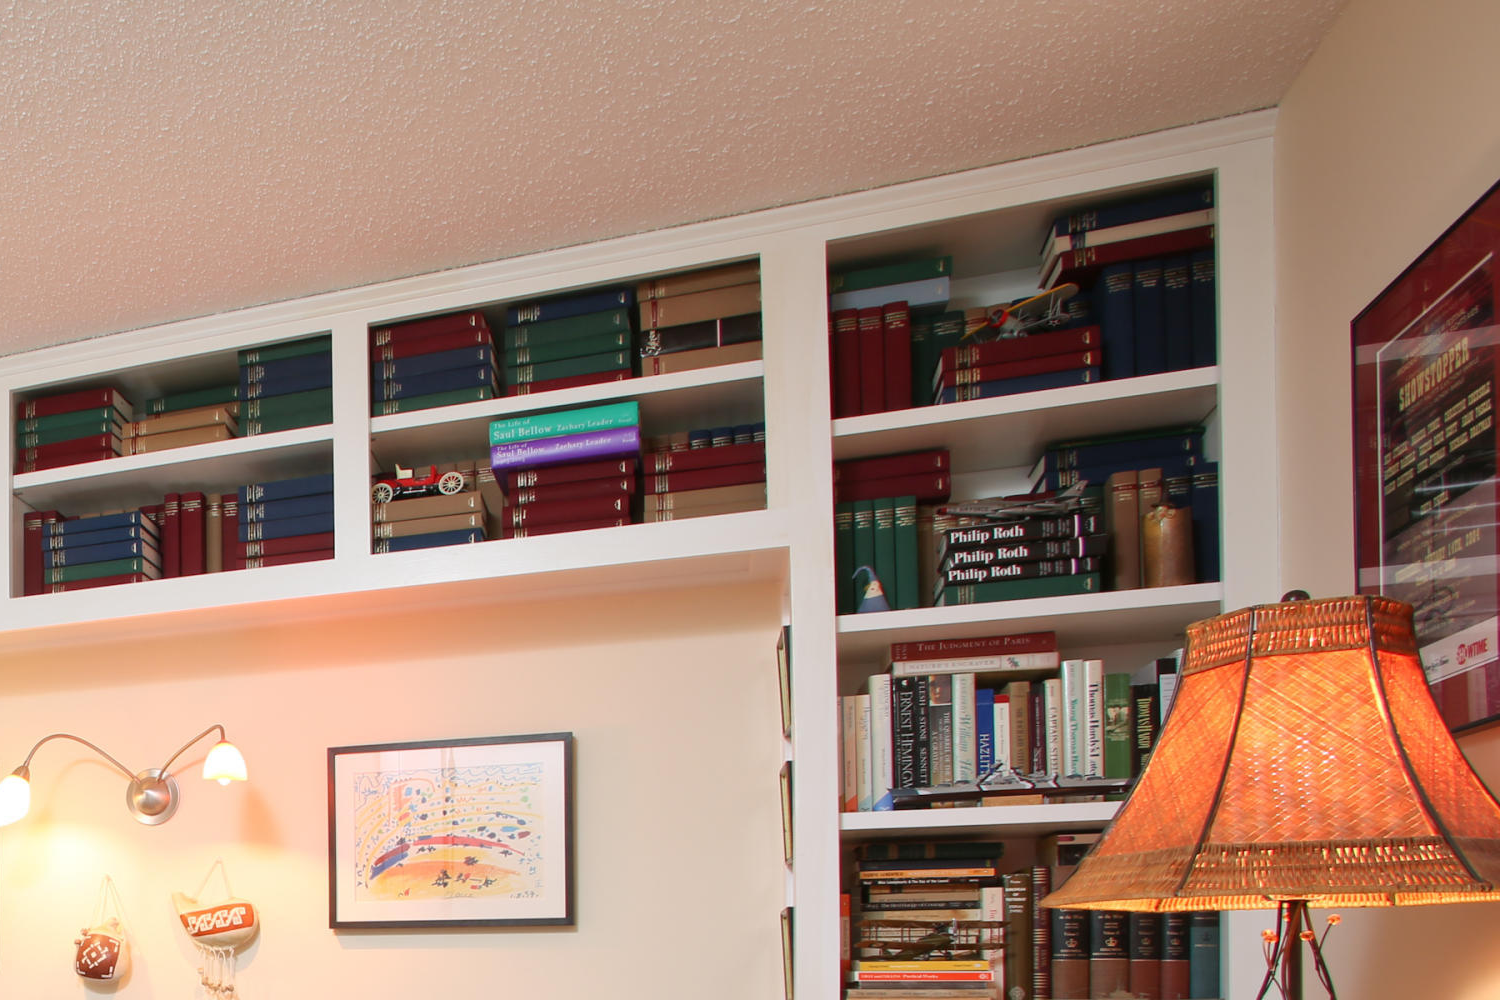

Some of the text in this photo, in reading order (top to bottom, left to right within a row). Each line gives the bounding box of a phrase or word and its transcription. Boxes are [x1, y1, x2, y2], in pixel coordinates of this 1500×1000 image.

[1399, 337, 1469, 412] SHOWSTOPPER
[494, 425, 552, 440] Saul Bellow
[508, 420, 521, 428] Life
[557, 422, 585, 432] Zachary
[588, 417, 613, 427] Leader
[497, 446, 545, 458] Saul Bellow
[556, 437, 612, 450] Zachary Leader
[950, 525, 1025, 544] Philip Roth
[954, 546, 1028, 564] Philip Roth
[948, 564, 1022, 582] Philip Roth
[917, 637, 1030, 651] THE JUDGMENT OF PARIS
[900, 691, 913, 730] ERNEST
[1088, 684, 1100, 754] Thomas Hardy's
[918, 681, 928, 784] FLESH STONE SENNETT
[959, 714, 972, 752] William
[1049, 707, 1059, 743] CAPTAIN
